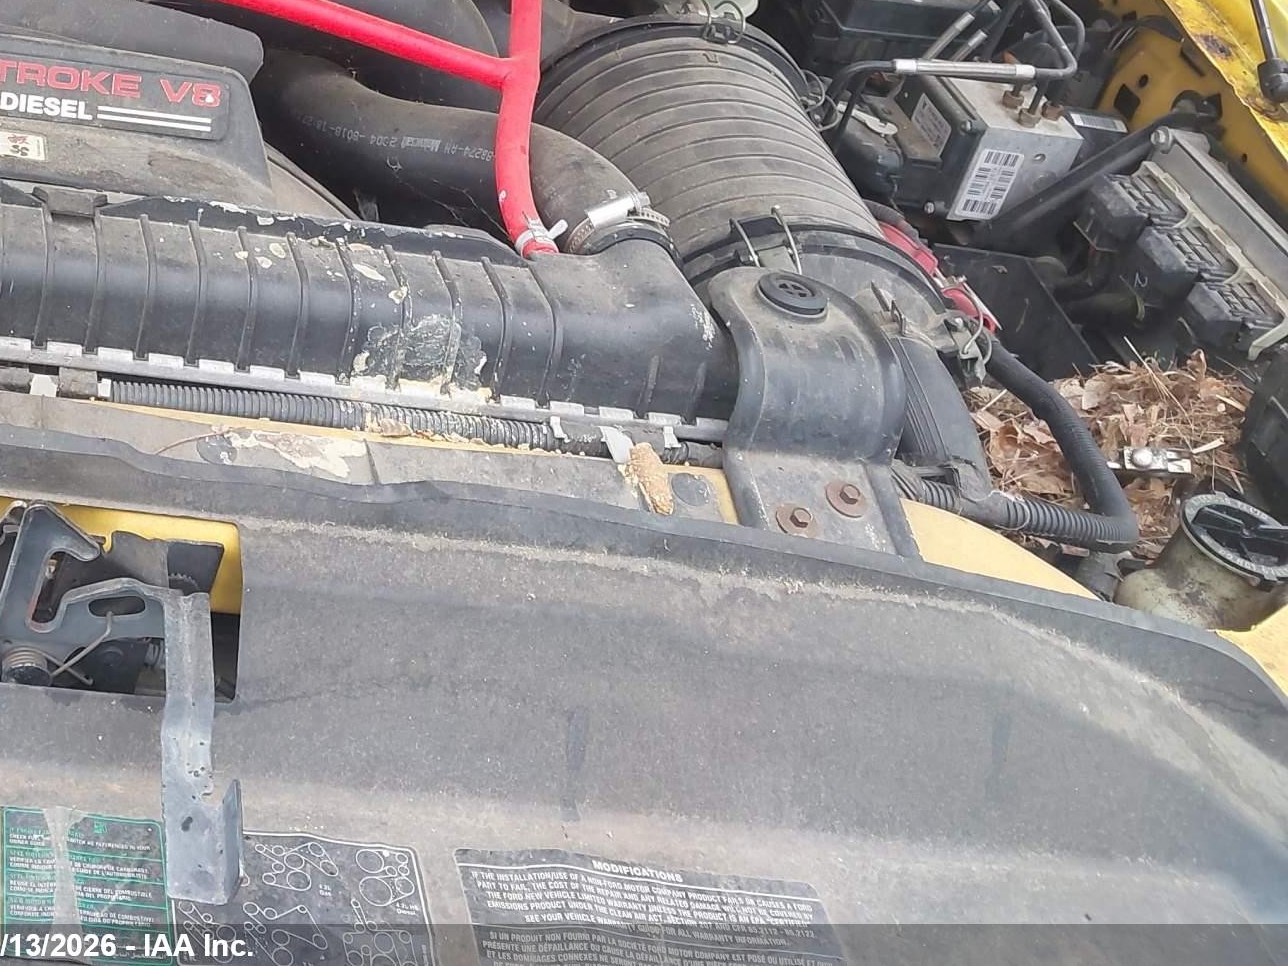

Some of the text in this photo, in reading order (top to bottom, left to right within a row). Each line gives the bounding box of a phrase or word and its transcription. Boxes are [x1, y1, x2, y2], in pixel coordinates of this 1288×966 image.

[159, 78, 222, 108] V8
[0, 91, 93, 121] DIESEL
[592, 860, 683, 883] MODIFICATIONS
[477, 880, 496, 889] PART
[499, 882, 508, 890] TO
[532, 882, 547, 890] THE
[548, 881, 568, 890] COST
[571, 882, 580, 890] OF
[582, 884, 596, 893] THE
[481, 871, 494, 880] THE
[496, 871, 568, 882] INSTALLATION/USE
[569, 872, 578, 880] OF
[623, 883, 651, 893] MOTOR
[652, 887, 686, 899] COMPANY
[687, 891, 722, 903] PRODUCT
[486, 891, 501, 900] THE
[503, 892, 523, 901] FORD
[523, 892, 542, 901] NEW
[543, 891, 576, 900] VEHICLE
[606, 897, 648, 911] WARRANTY
[693, 911, 727, 921] PRODUCT
[486, 900, 529, 911] EMISSIONS
[530, 901, 566, 911] PRODUCT
[593, 904, 609, 914] THE
[524, 914, 540, 923] SEE
[541, 913, 563, 922] YOUR
[564, 912, 596, 923] VEHICLE
[486, 951, 496, 959] ET
[497, 952, 512, 960] LES
[513, 954, 556, 963] DOMMAGES
[558, 952, 597, 962] CONNEXES
[499, 932, 509, 941] UN
[511, 933, 543, 943] PRODUIT
[544, 933, 561, 942] NON
[563, 932, 591, 941] FOURNI
[592, 935, 607, 944] PAR
[608, 936, 616, 945] LA
[648, 943, 667, 953] FORD
[668, 946, 693, 957] MOTOR
[694, 949, 730, 961] COMPANY
[521, 944, 537, 952] UNE
